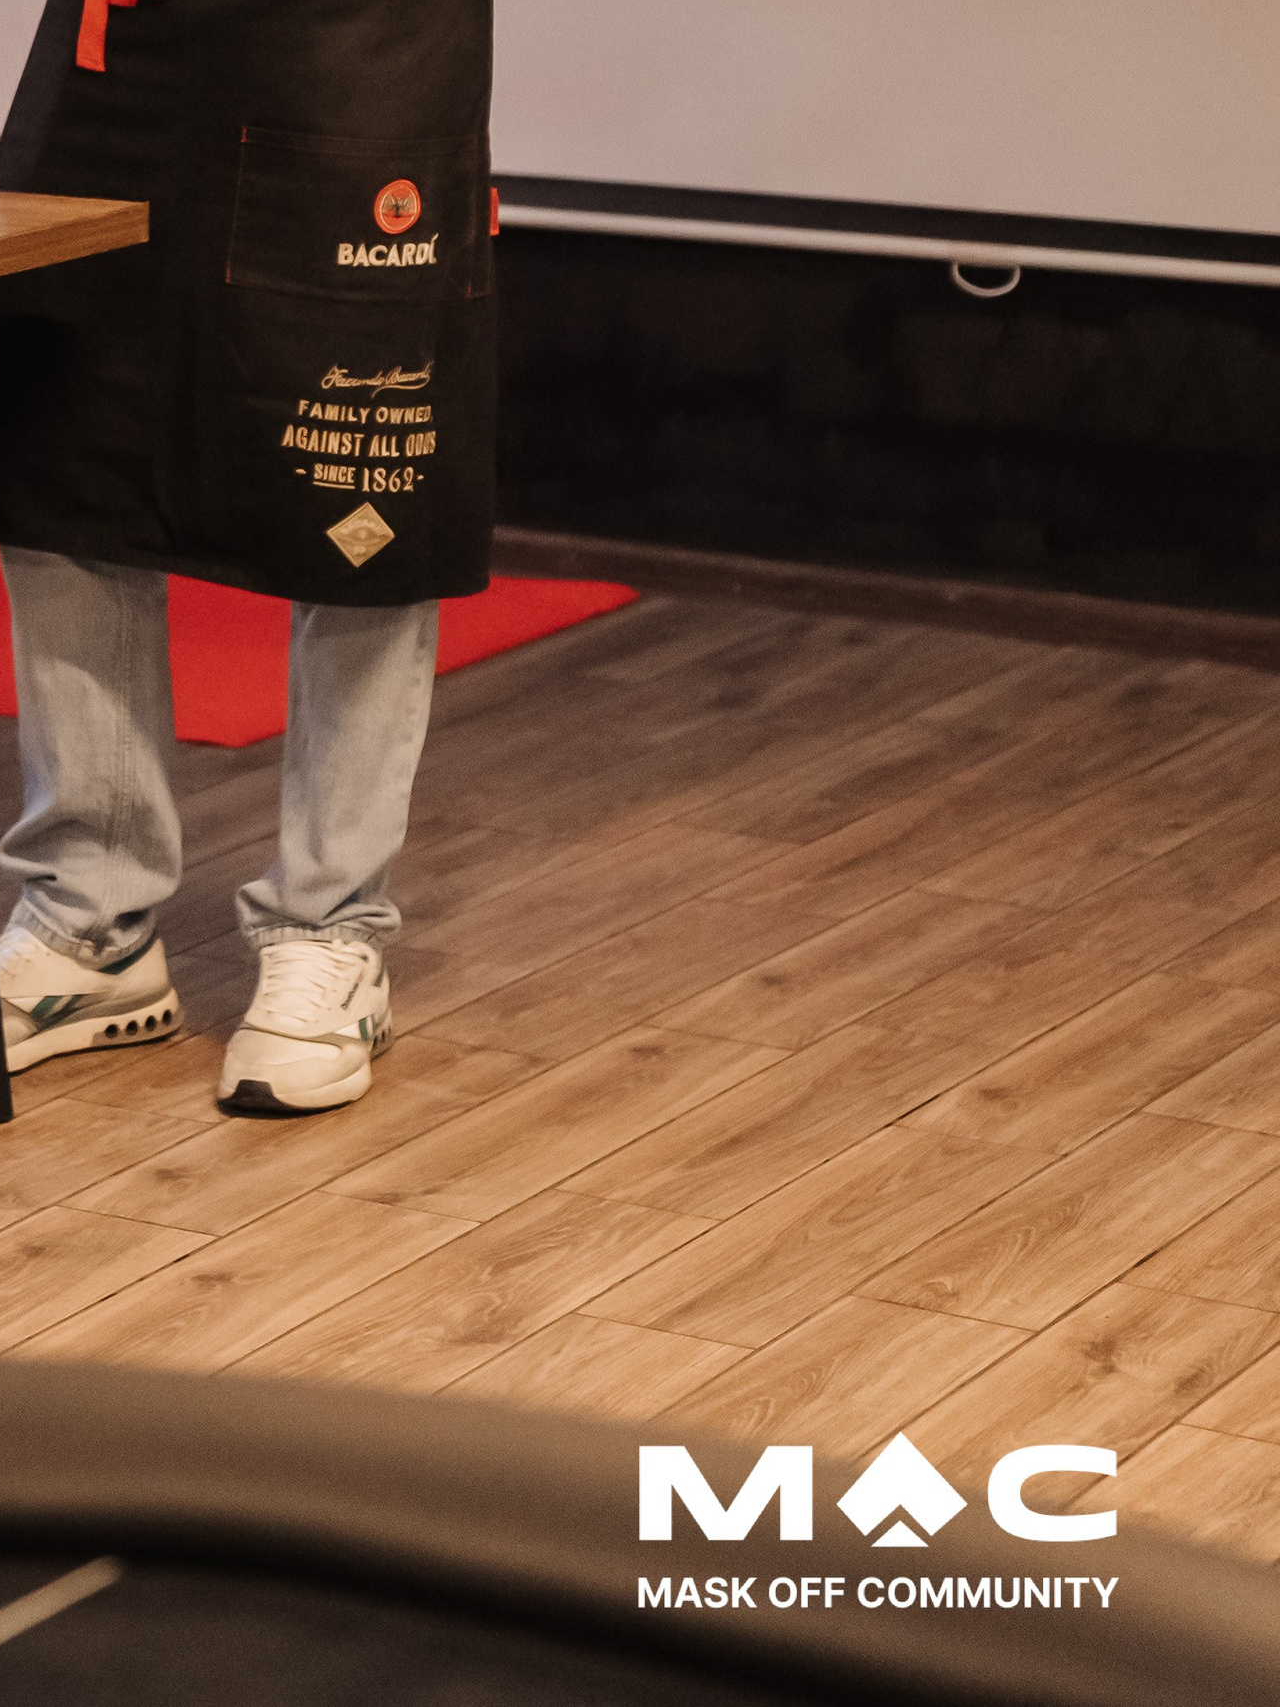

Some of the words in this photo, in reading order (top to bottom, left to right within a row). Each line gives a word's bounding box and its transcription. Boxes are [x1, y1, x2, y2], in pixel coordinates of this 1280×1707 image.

[298, 399, 370, 424] FAMILY
[375, 405, 433, 424] OWNED
[281, 424, 365, 457] AGAINST
[368, 434, 400, 458] ALL
[313, 462, 356, 484] SINCE
[361, 466, 414, 493] 1862
